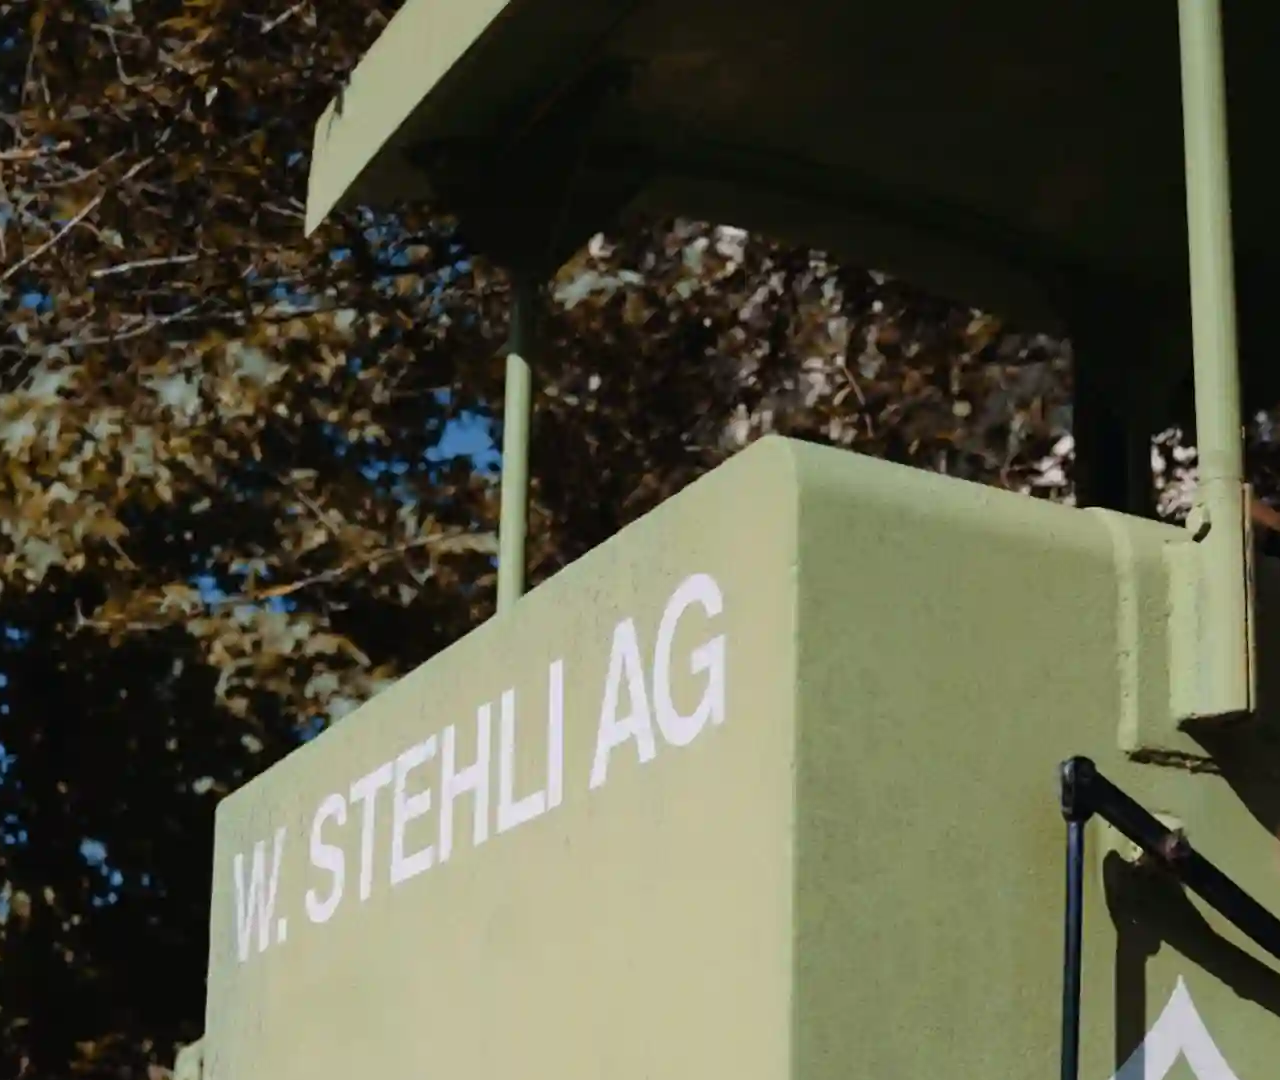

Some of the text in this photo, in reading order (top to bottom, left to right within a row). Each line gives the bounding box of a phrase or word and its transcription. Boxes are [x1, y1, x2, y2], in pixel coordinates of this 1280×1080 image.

[233, 573, 725, 962] W. STEHLI AG
